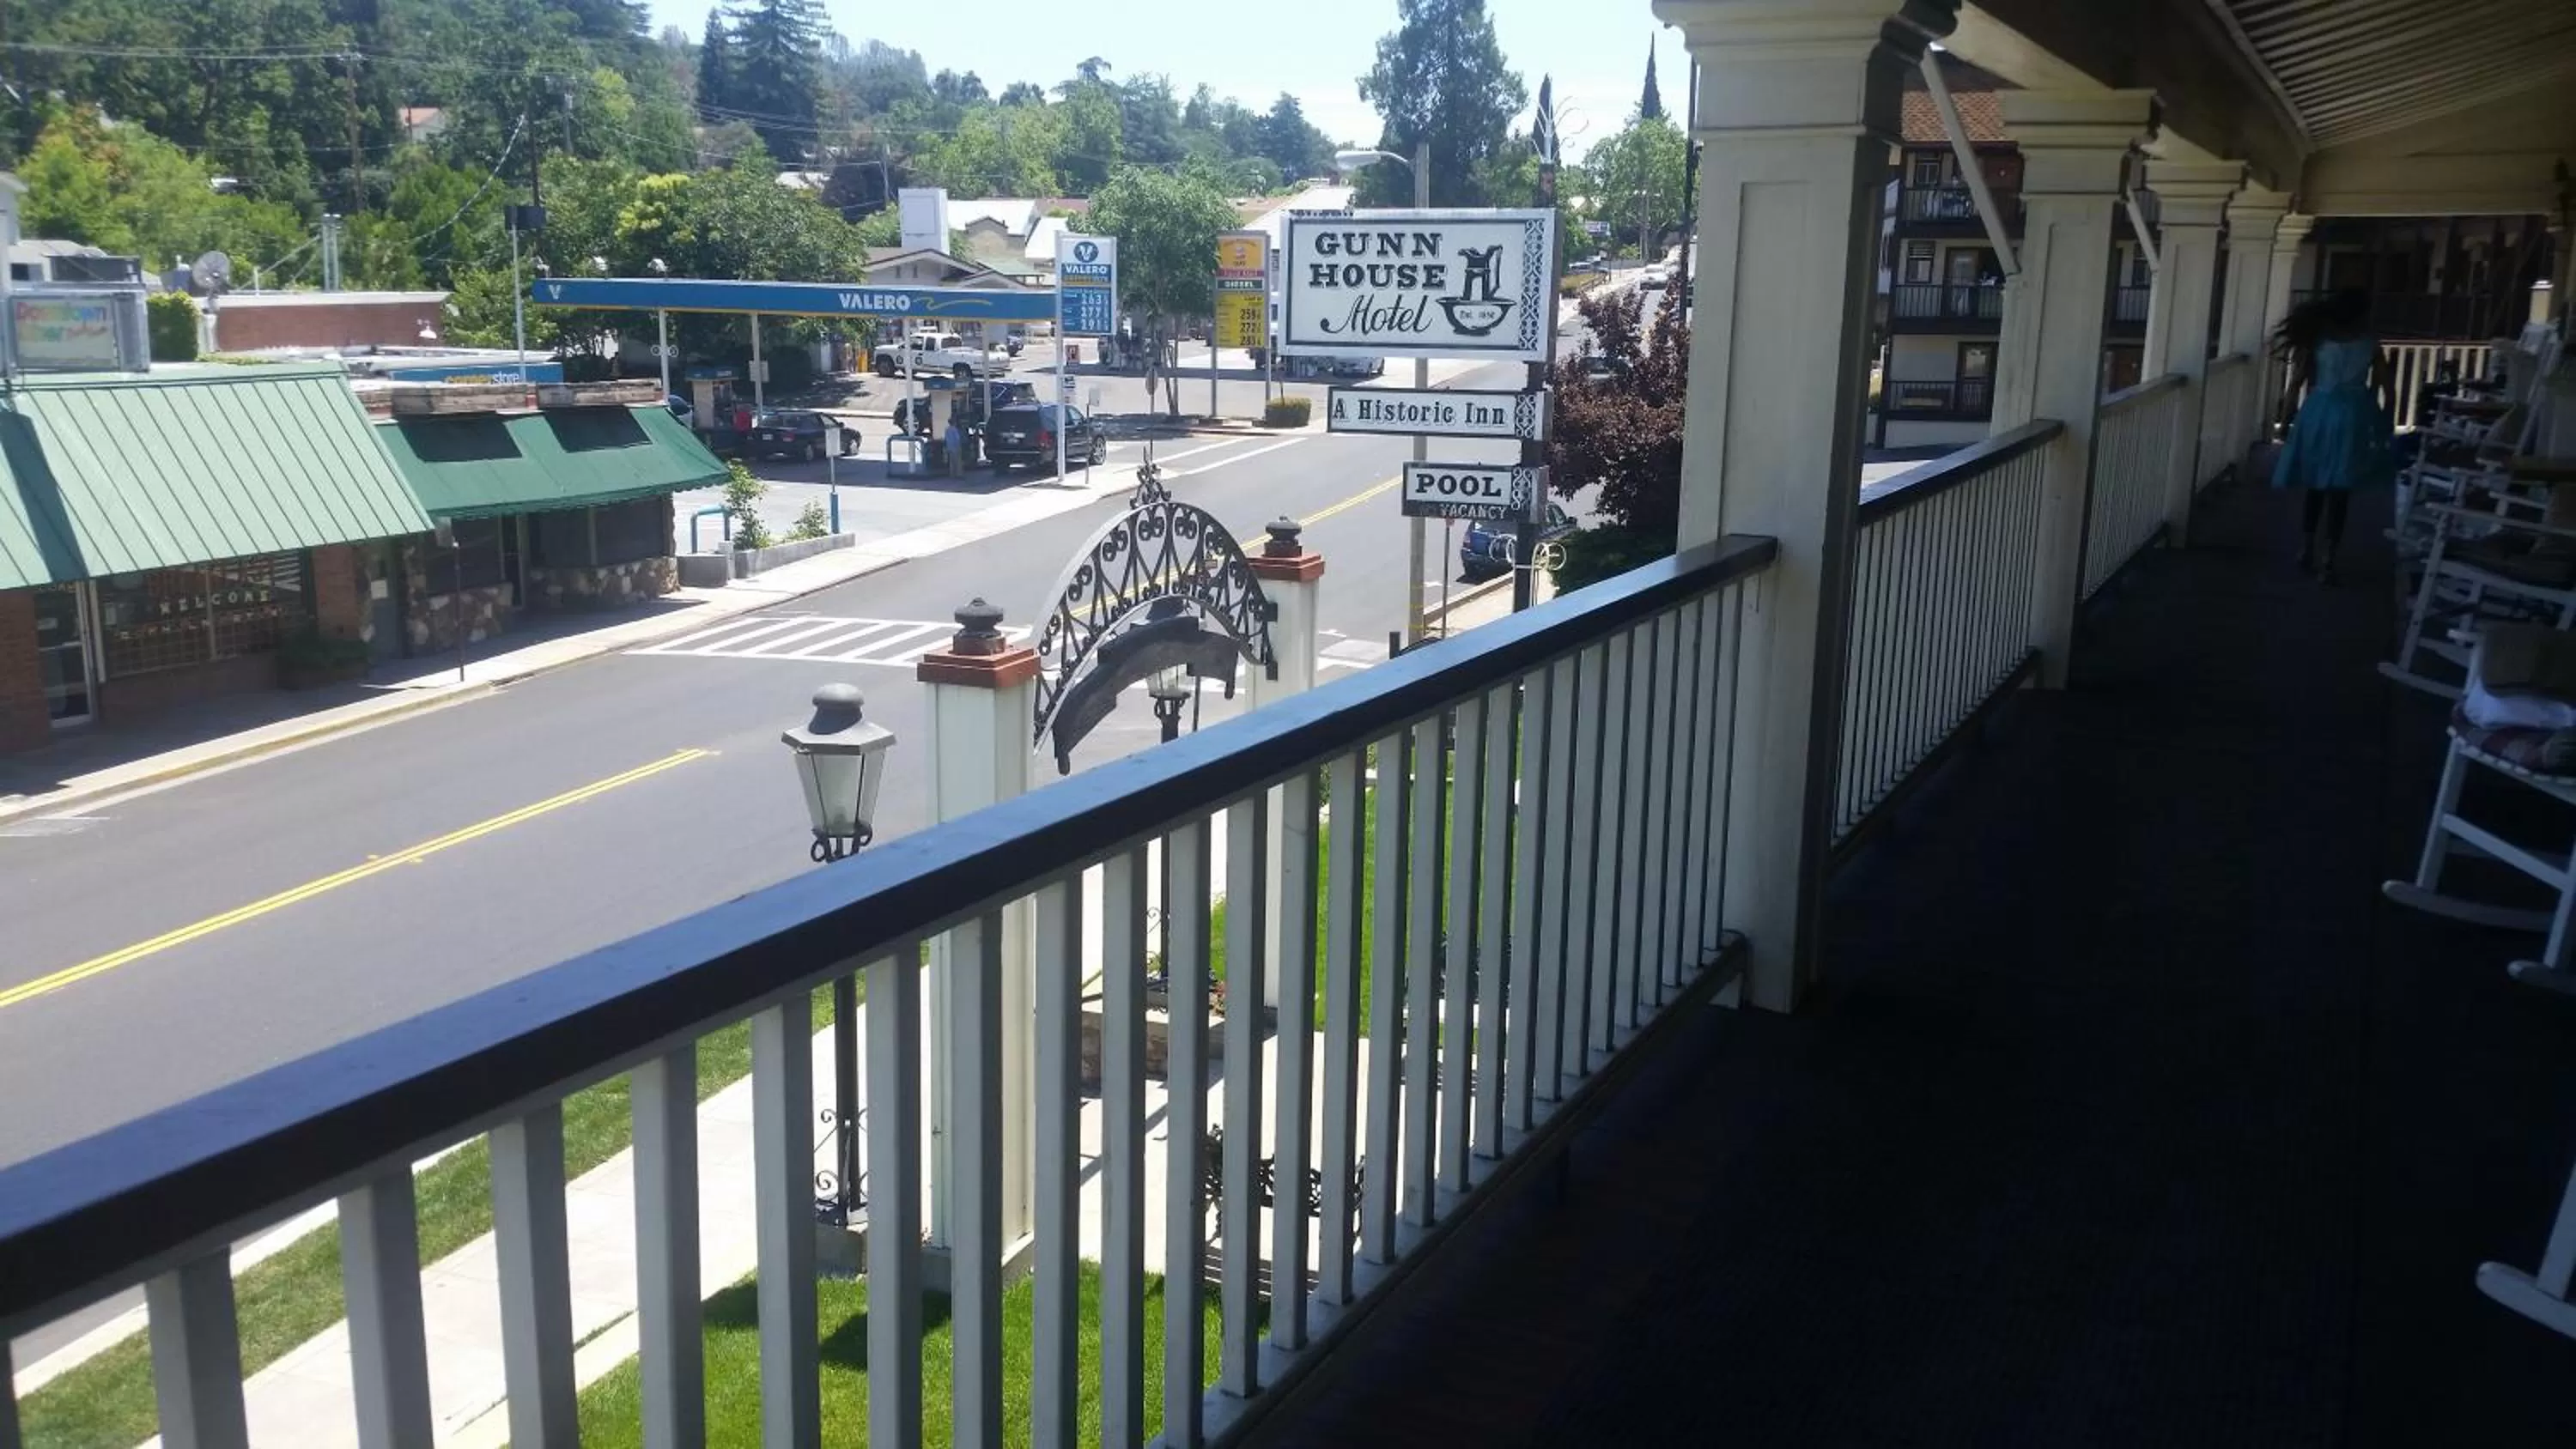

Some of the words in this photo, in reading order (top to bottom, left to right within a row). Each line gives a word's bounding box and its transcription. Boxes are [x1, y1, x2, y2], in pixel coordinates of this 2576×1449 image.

[1315, 232, 1443, 258] GUNN
[1066, 265, 1108, 274] VALERO
[1309, 264, 1446, 289] HOUSE
[838, 293, 911, 311] VALERO
[1321, 294, 1432, 335] Motel
[1333, 397, 1346, 420] A
[1358, 399, 1455, 423] Historic
[1464, 403, 1505, 425] Inn
[1415, 473, 1502, 497] POOL
[1440, 503, 1507, 519] VACANCY
[159, 589, 270, 615] WELCOME
